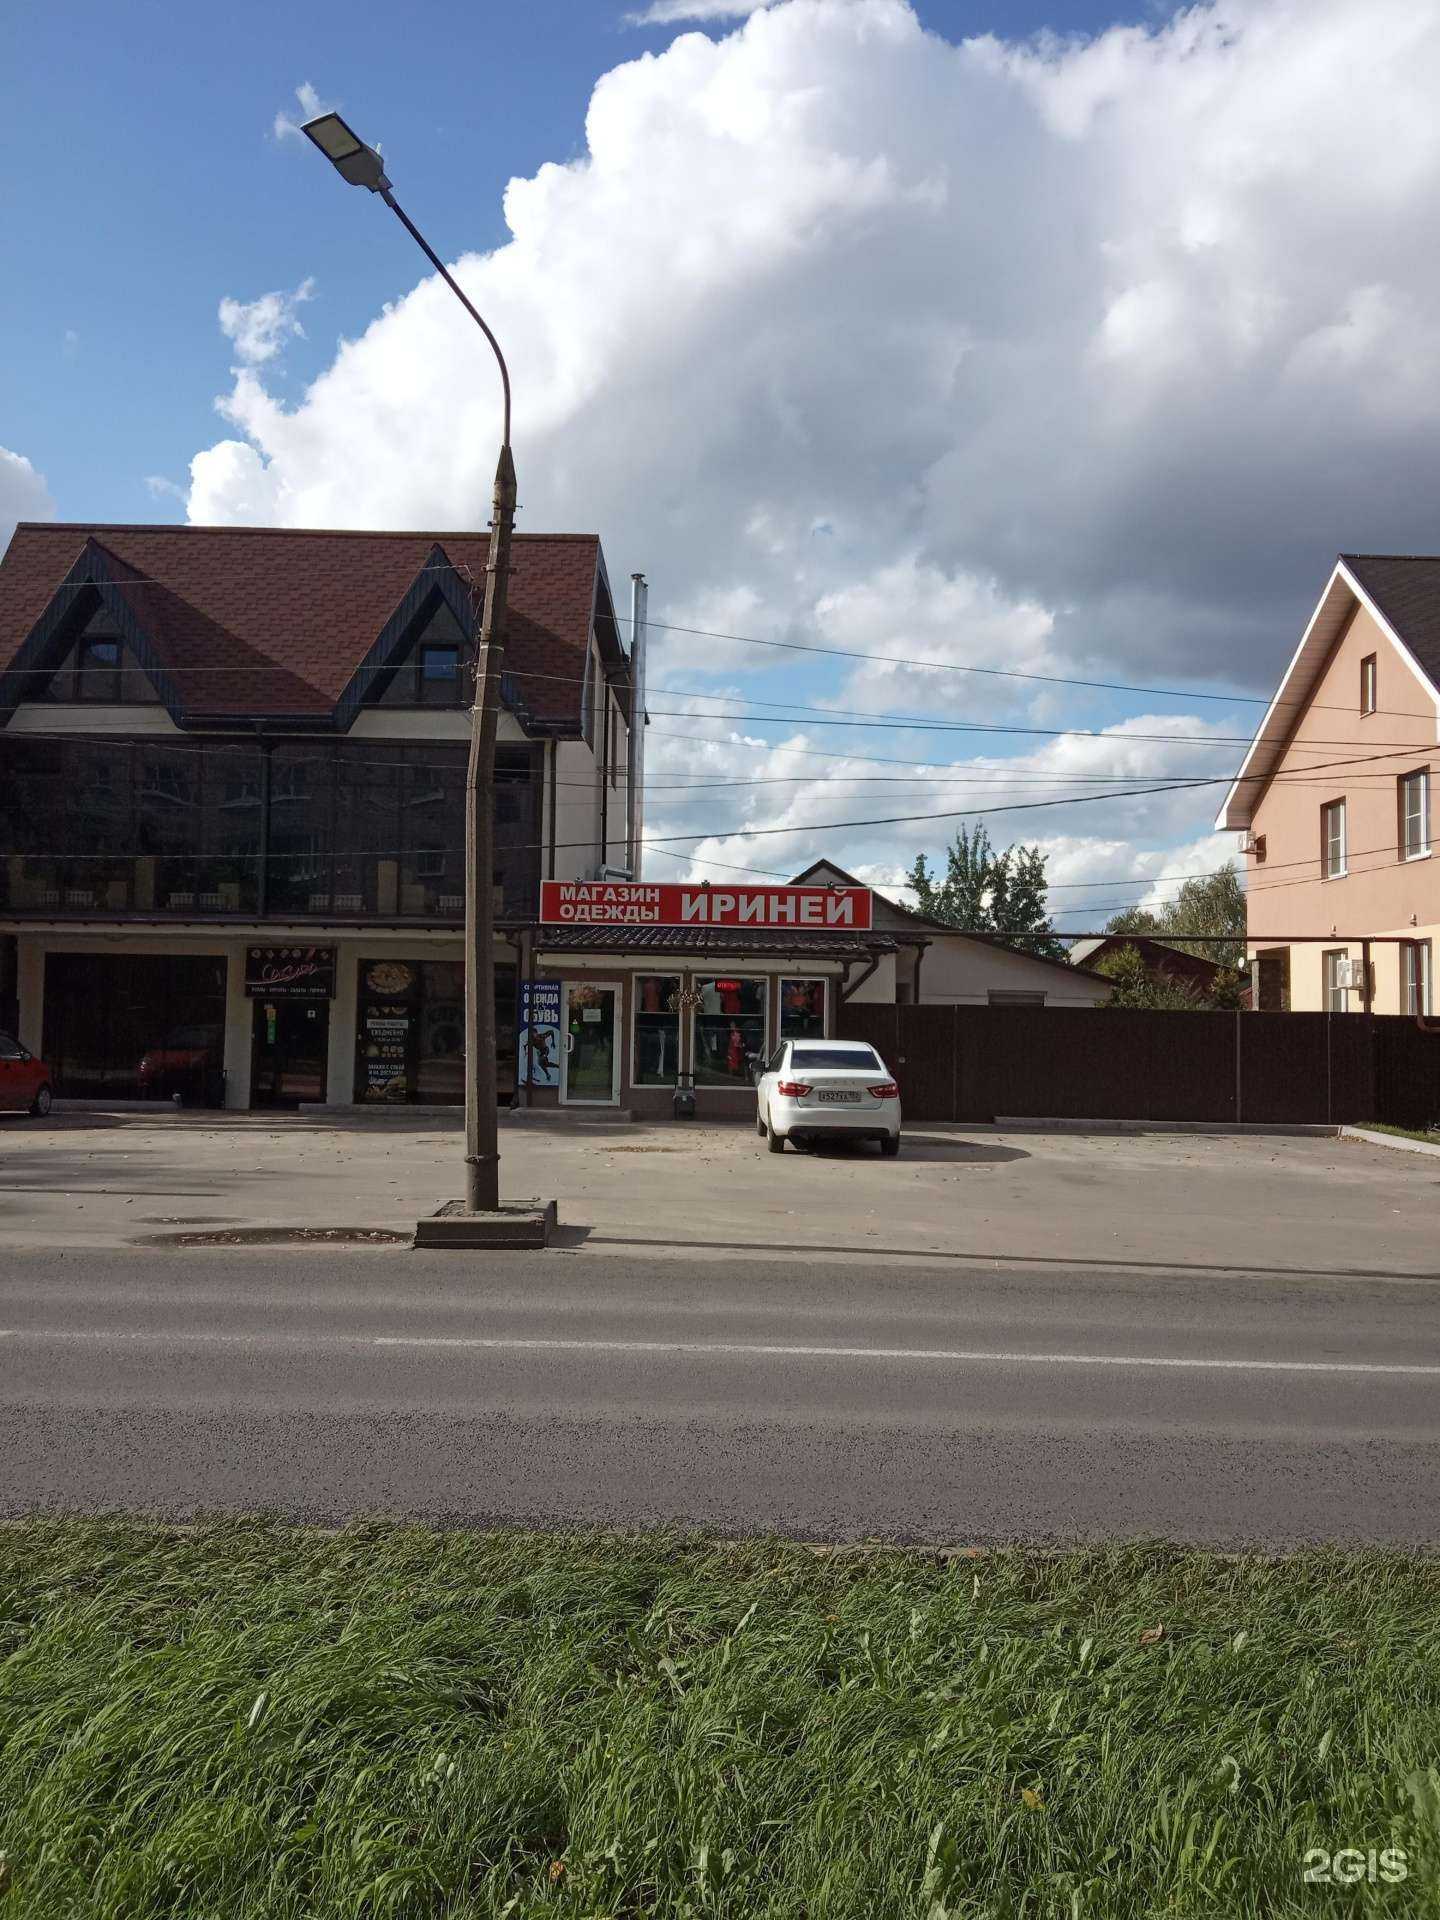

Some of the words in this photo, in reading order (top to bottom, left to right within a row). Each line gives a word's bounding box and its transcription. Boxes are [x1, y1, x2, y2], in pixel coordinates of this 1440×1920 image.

[559, 886, 661, 903] МАГАЗИН
[559, 903, 661, 923] ОДЕЖДЫ
[681, 890, 854, 924] ИРИНЕЙ
[523, 993, 559, 1006] ОЕЖДА
